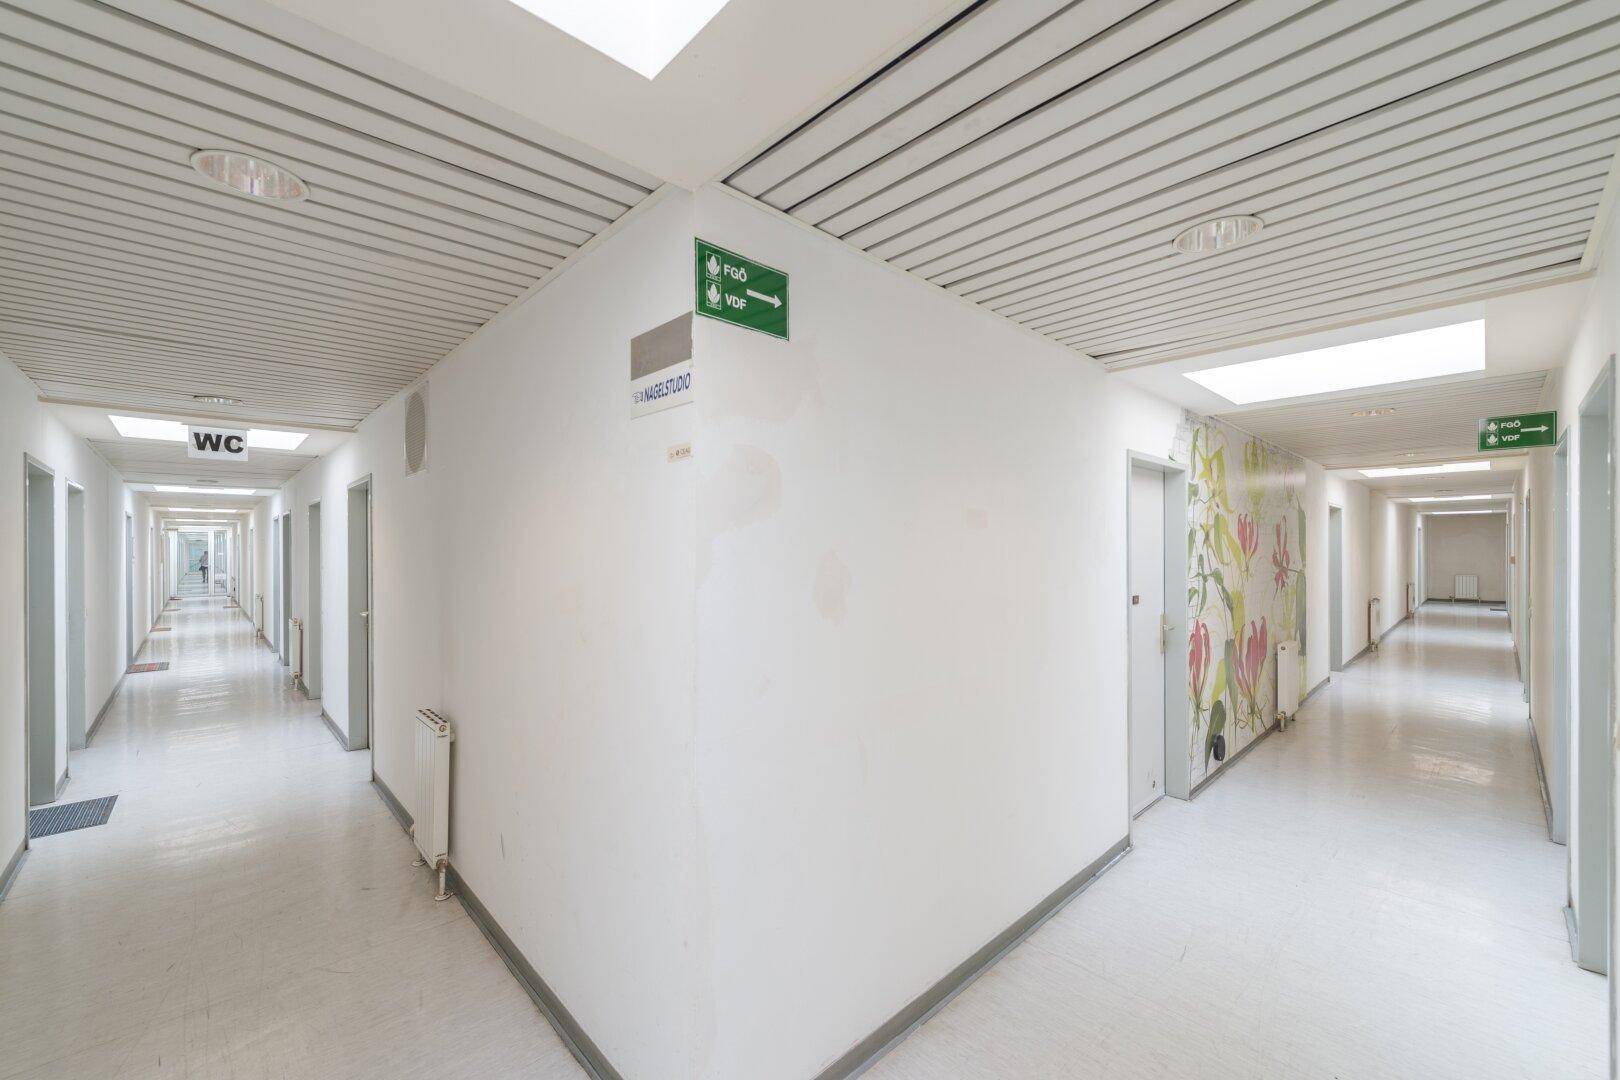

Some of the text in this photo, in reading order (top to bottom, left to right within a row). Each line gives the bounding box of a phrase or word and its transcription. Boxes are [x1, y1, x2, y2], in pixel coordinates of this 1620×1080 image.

[723, 263, 747, 282] FGÖ
[725, 293, 747, 309] VDF
[644, 372, 691, 402] NAGELSTUDIO
[1500, 420, 1521, 429] FGÖ
[193, 432, 244, 453] WC
